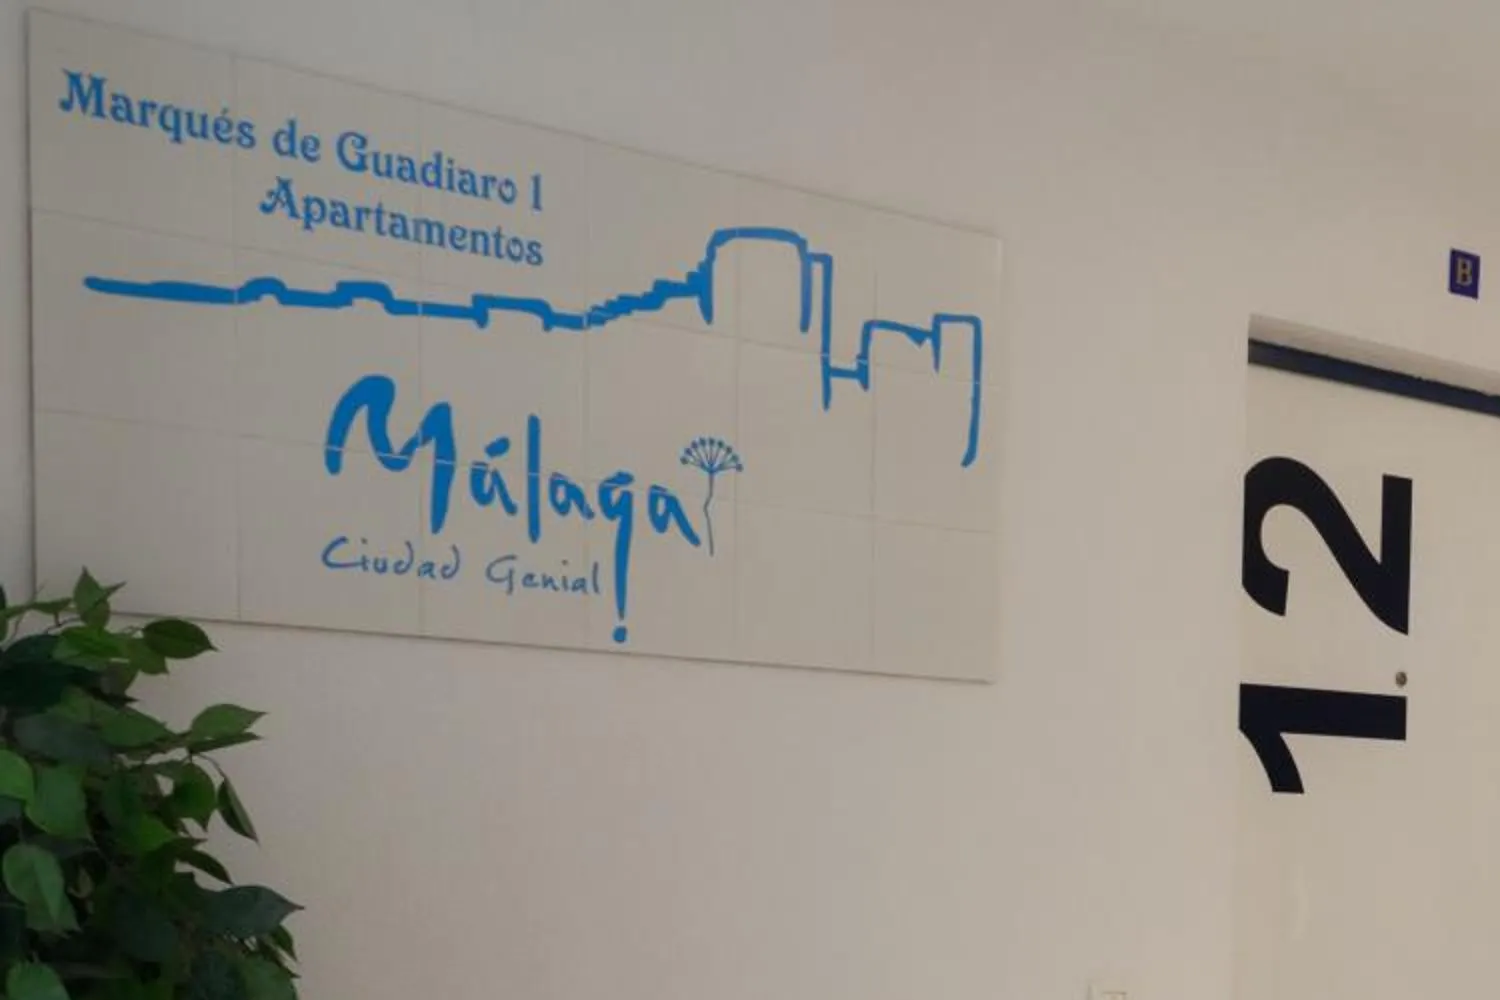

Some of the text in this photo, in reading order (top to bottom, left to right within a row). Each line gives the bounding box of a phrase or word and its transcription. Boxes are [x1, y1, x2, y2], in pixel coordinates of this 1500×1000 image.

[58, 68, 257, 147] Marqués
[273, 117, 321, 163] de
[336, 131, 517, 205] Guadiaro
[258, 176, 544, 266] Apartamentos
[1456, 257, 1473, 286] B
[323, 374, 701, 644] Málaga
[321, 536, 600, 597] Ciudad Genial
